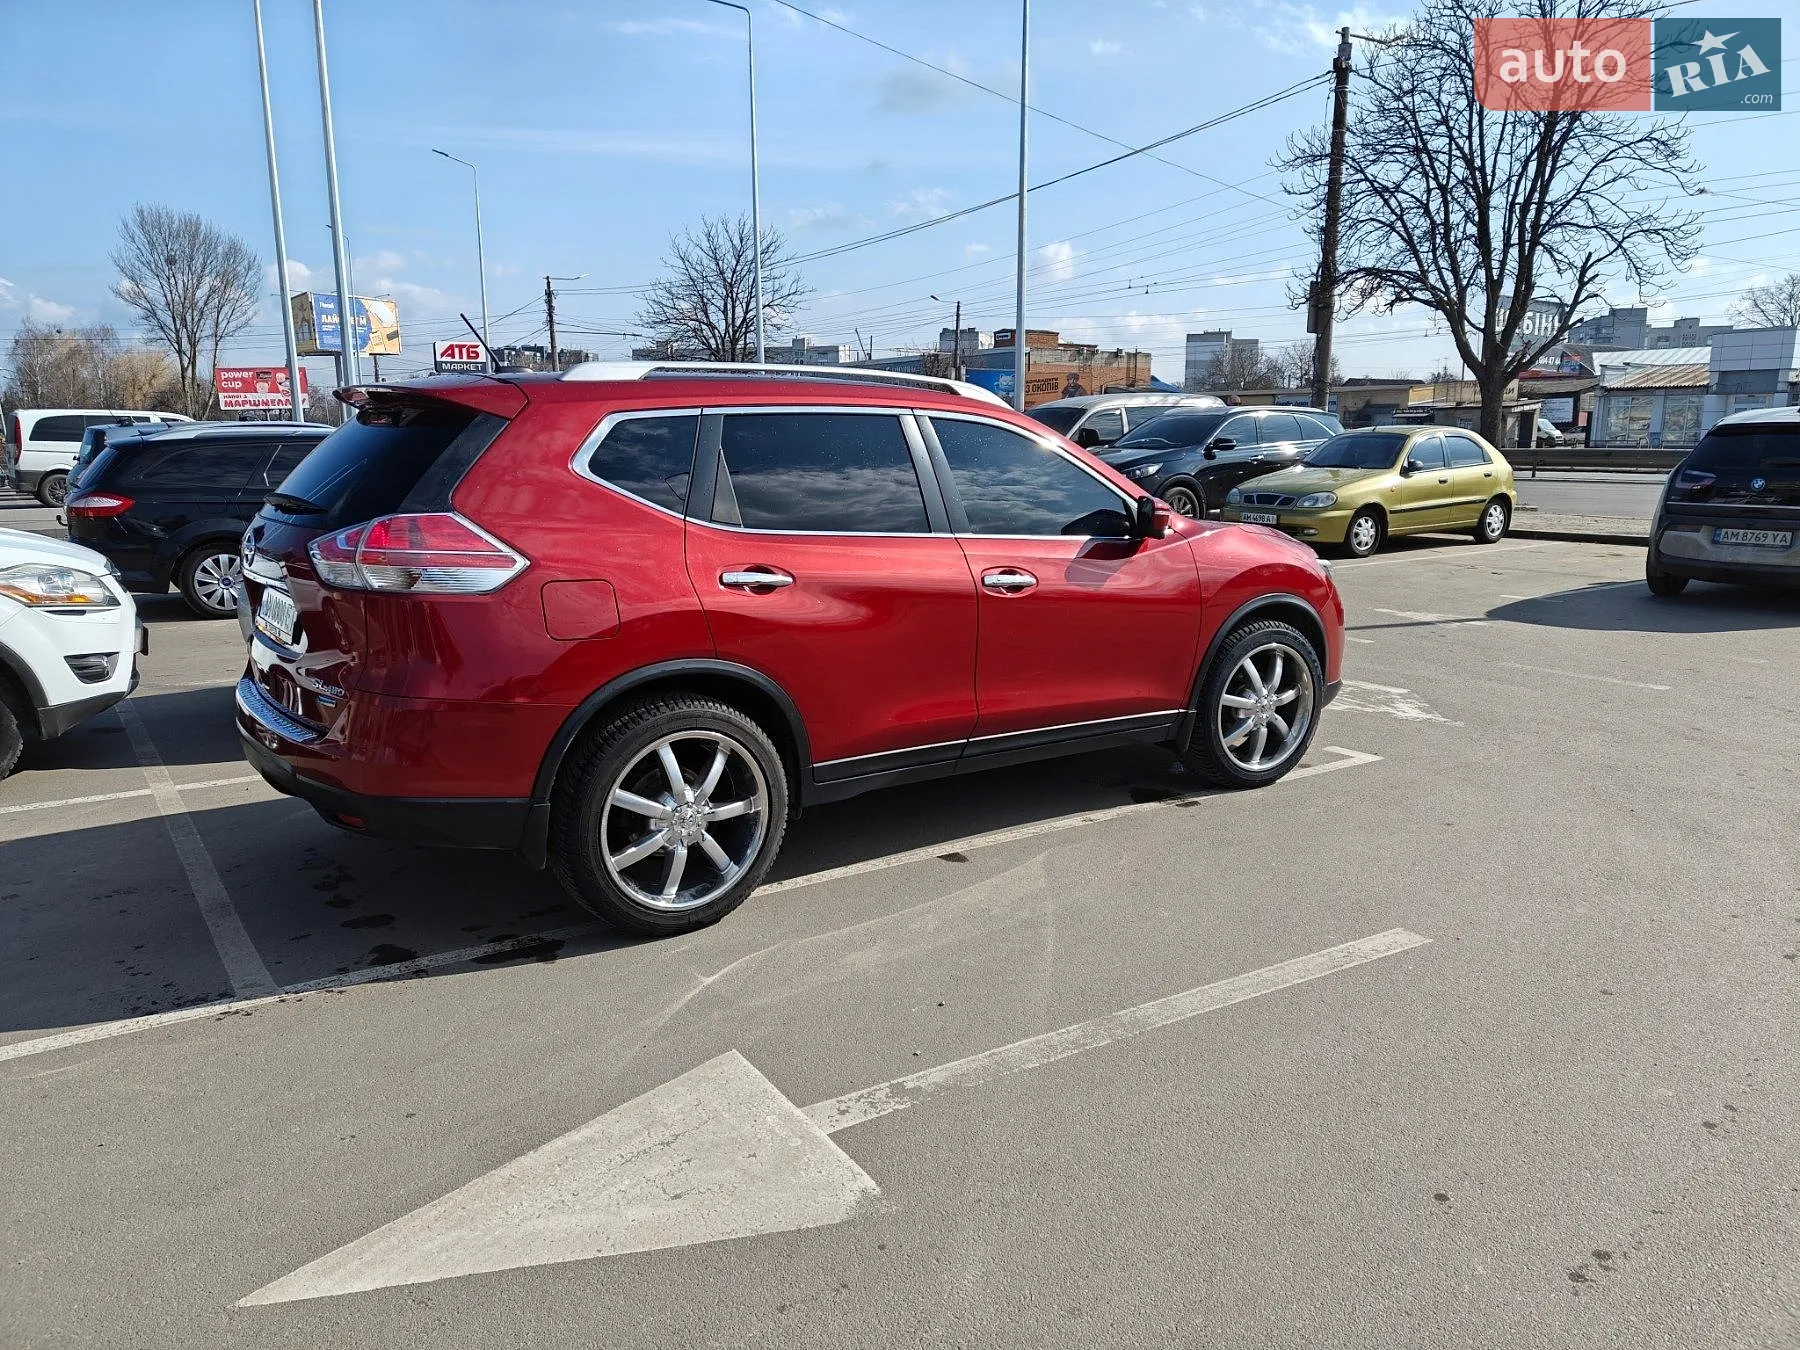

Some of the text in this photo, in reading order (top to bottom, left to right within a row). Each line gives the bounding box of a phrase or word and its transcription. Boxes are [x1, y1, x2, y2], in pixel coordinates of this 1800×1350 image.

[440, 343, 480, 360] АТБ
[442, 363, 482, 371] МАРКЕТ
[221, 371, 253, 380] power
[221, 381, 243, 389] cup
[1031, 382, 1059, 393] ОКОПІВ
[1722, 530, 1788, 544] AM 8769 YA
